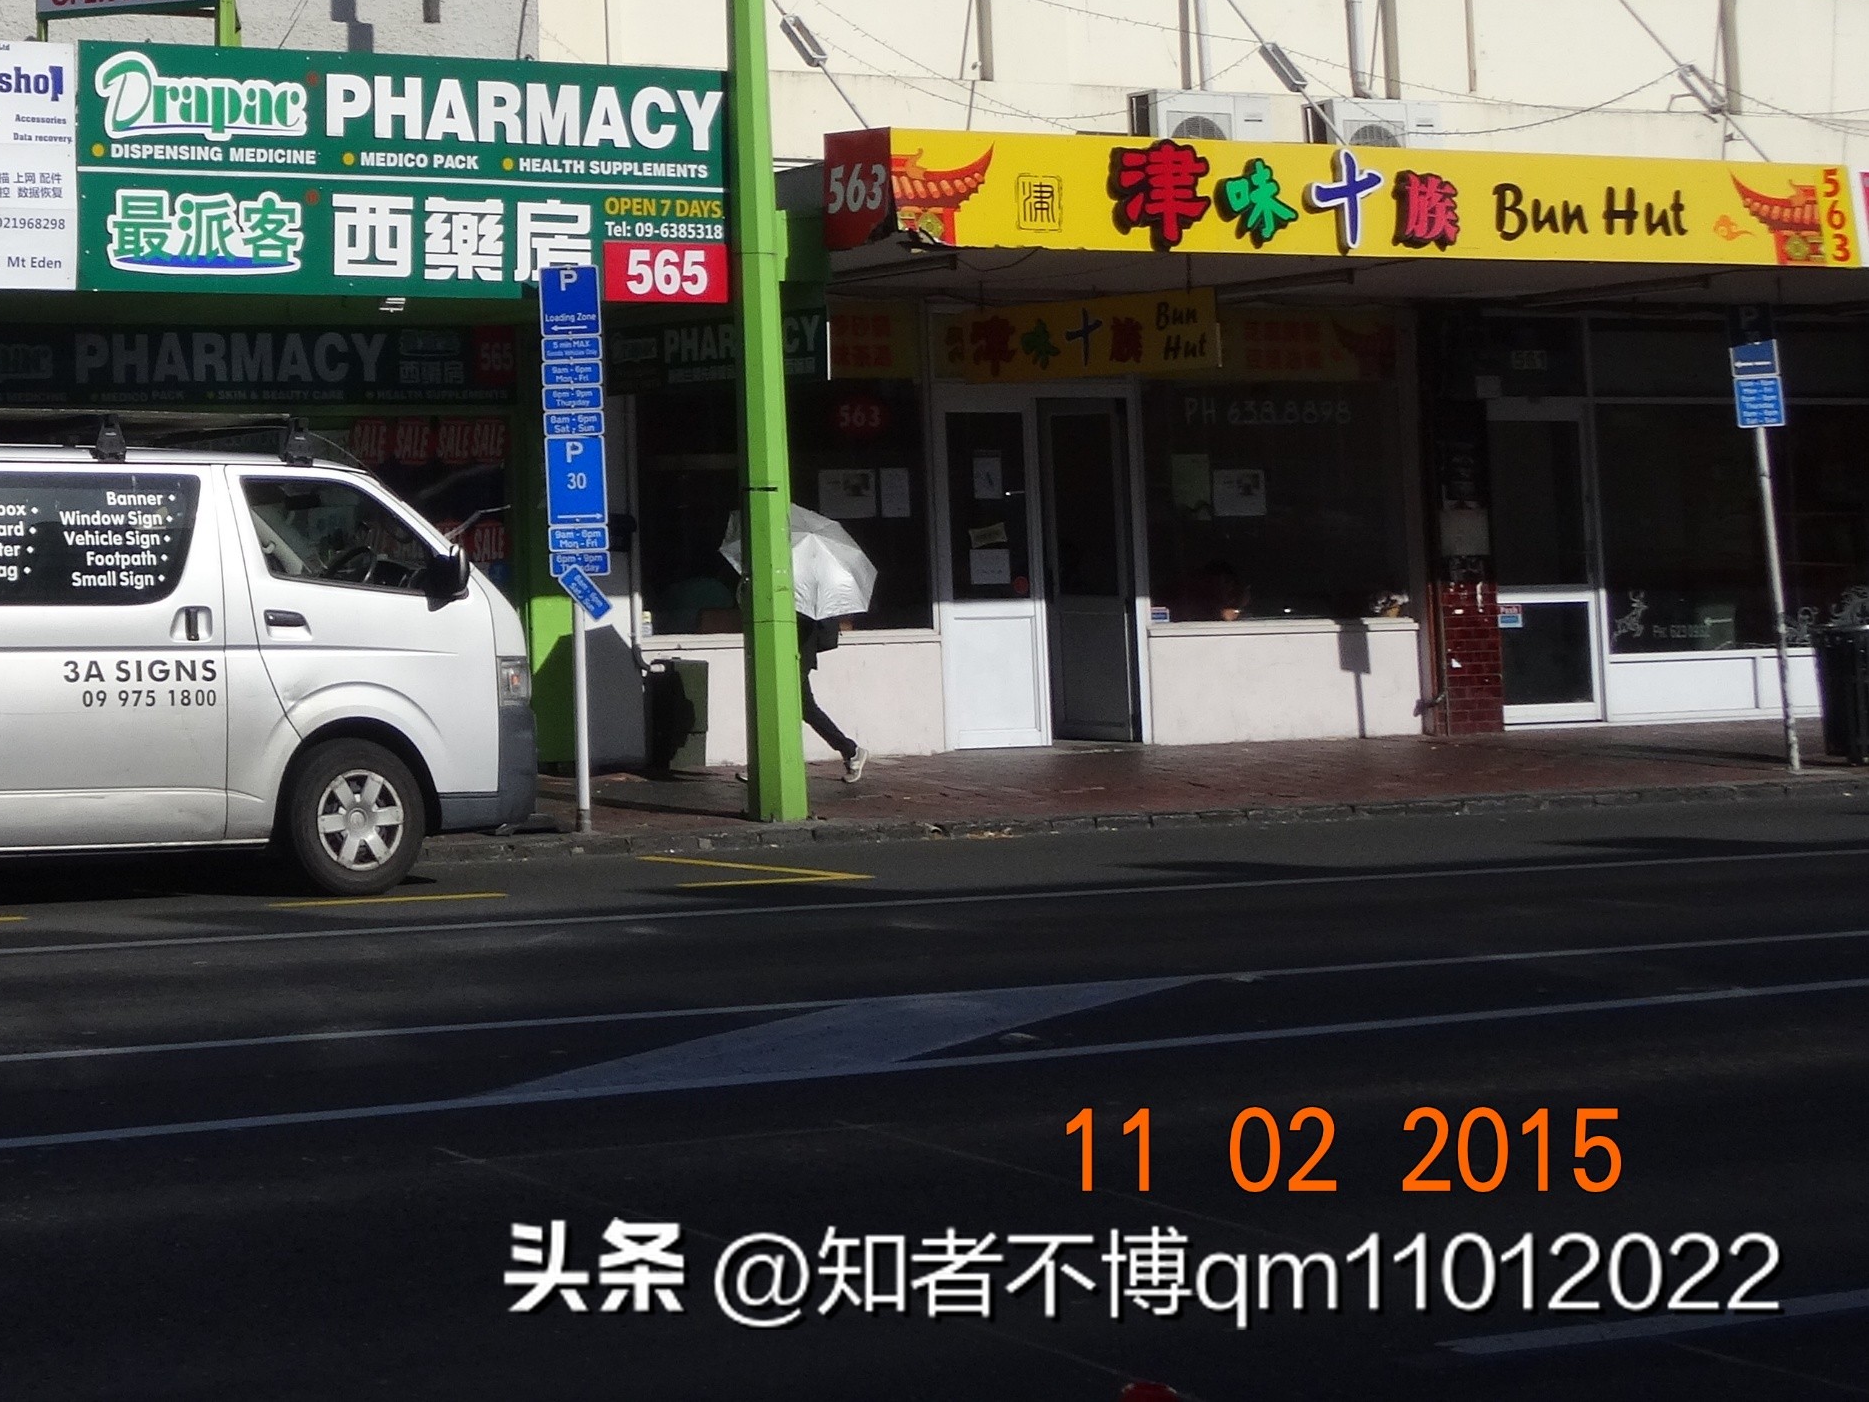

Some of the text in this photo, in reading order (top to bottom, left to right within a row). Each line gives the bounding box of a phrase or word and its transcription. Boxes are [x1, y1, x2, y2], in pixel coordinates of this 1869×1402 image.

[95, 51, 308, 140] Drapac
[15, 114, 67, 125] Accessories
[326, 74, 723, 153] PHARMACY
[13, 132, 32, 142] Data
[111, 143, 316, 165] DISPENSING MEDICINE
[360, 151, 479, 170] MEDICO PACK
[13, 172, 36, 184] 上网
[39, 172, 62, 184] 配件
[518, 156, 708, 179] HEALTH SUPPLEMENTS
[17, 186, 63, 198] 数据恢复
[827, 163, 888, 214] 563
[1112, 139, 1460, 254] 津味十族
[604, 197, 722, 219] OPEN 7 DAYS
[1493, 183, 1689, 241] Bun Hut
[1822, 169, 1851, 262] 563
[110, 189, 304, 270] 最派客
[331, 192, 592, 282] 西藥房
[605, 221, 723, 240] Tel: 09-6385318
[7, 255, 26, 268] Mt
[30, 256, 62, 269] Eden
[626, 249, 708, 295] 565
[559, 270, 578, 291] P
[545, 312, 597, 322] Loading Zone
[1156, 302, 1207, 361] Bun Hut
[75, 332, 387, 384] PHARMACY
[480, 342, 514, 371] 565
[840, 404, 881, 428] 563
[566, 441, 583, 463] P
[567, 473, 587, 489] 30
[106, 491, 163, 505] Banner
[60, 510, 162, 529] Window Sign
[64, 530, 160, 549] Vehicle Sign
[86, 550, 157, 569] Footpath
[72, 571, 154, 589] Small Sign
[63, 660, 217, 682] 3A SIGNS
[82, 690, 217, 707] 09 975 1800
